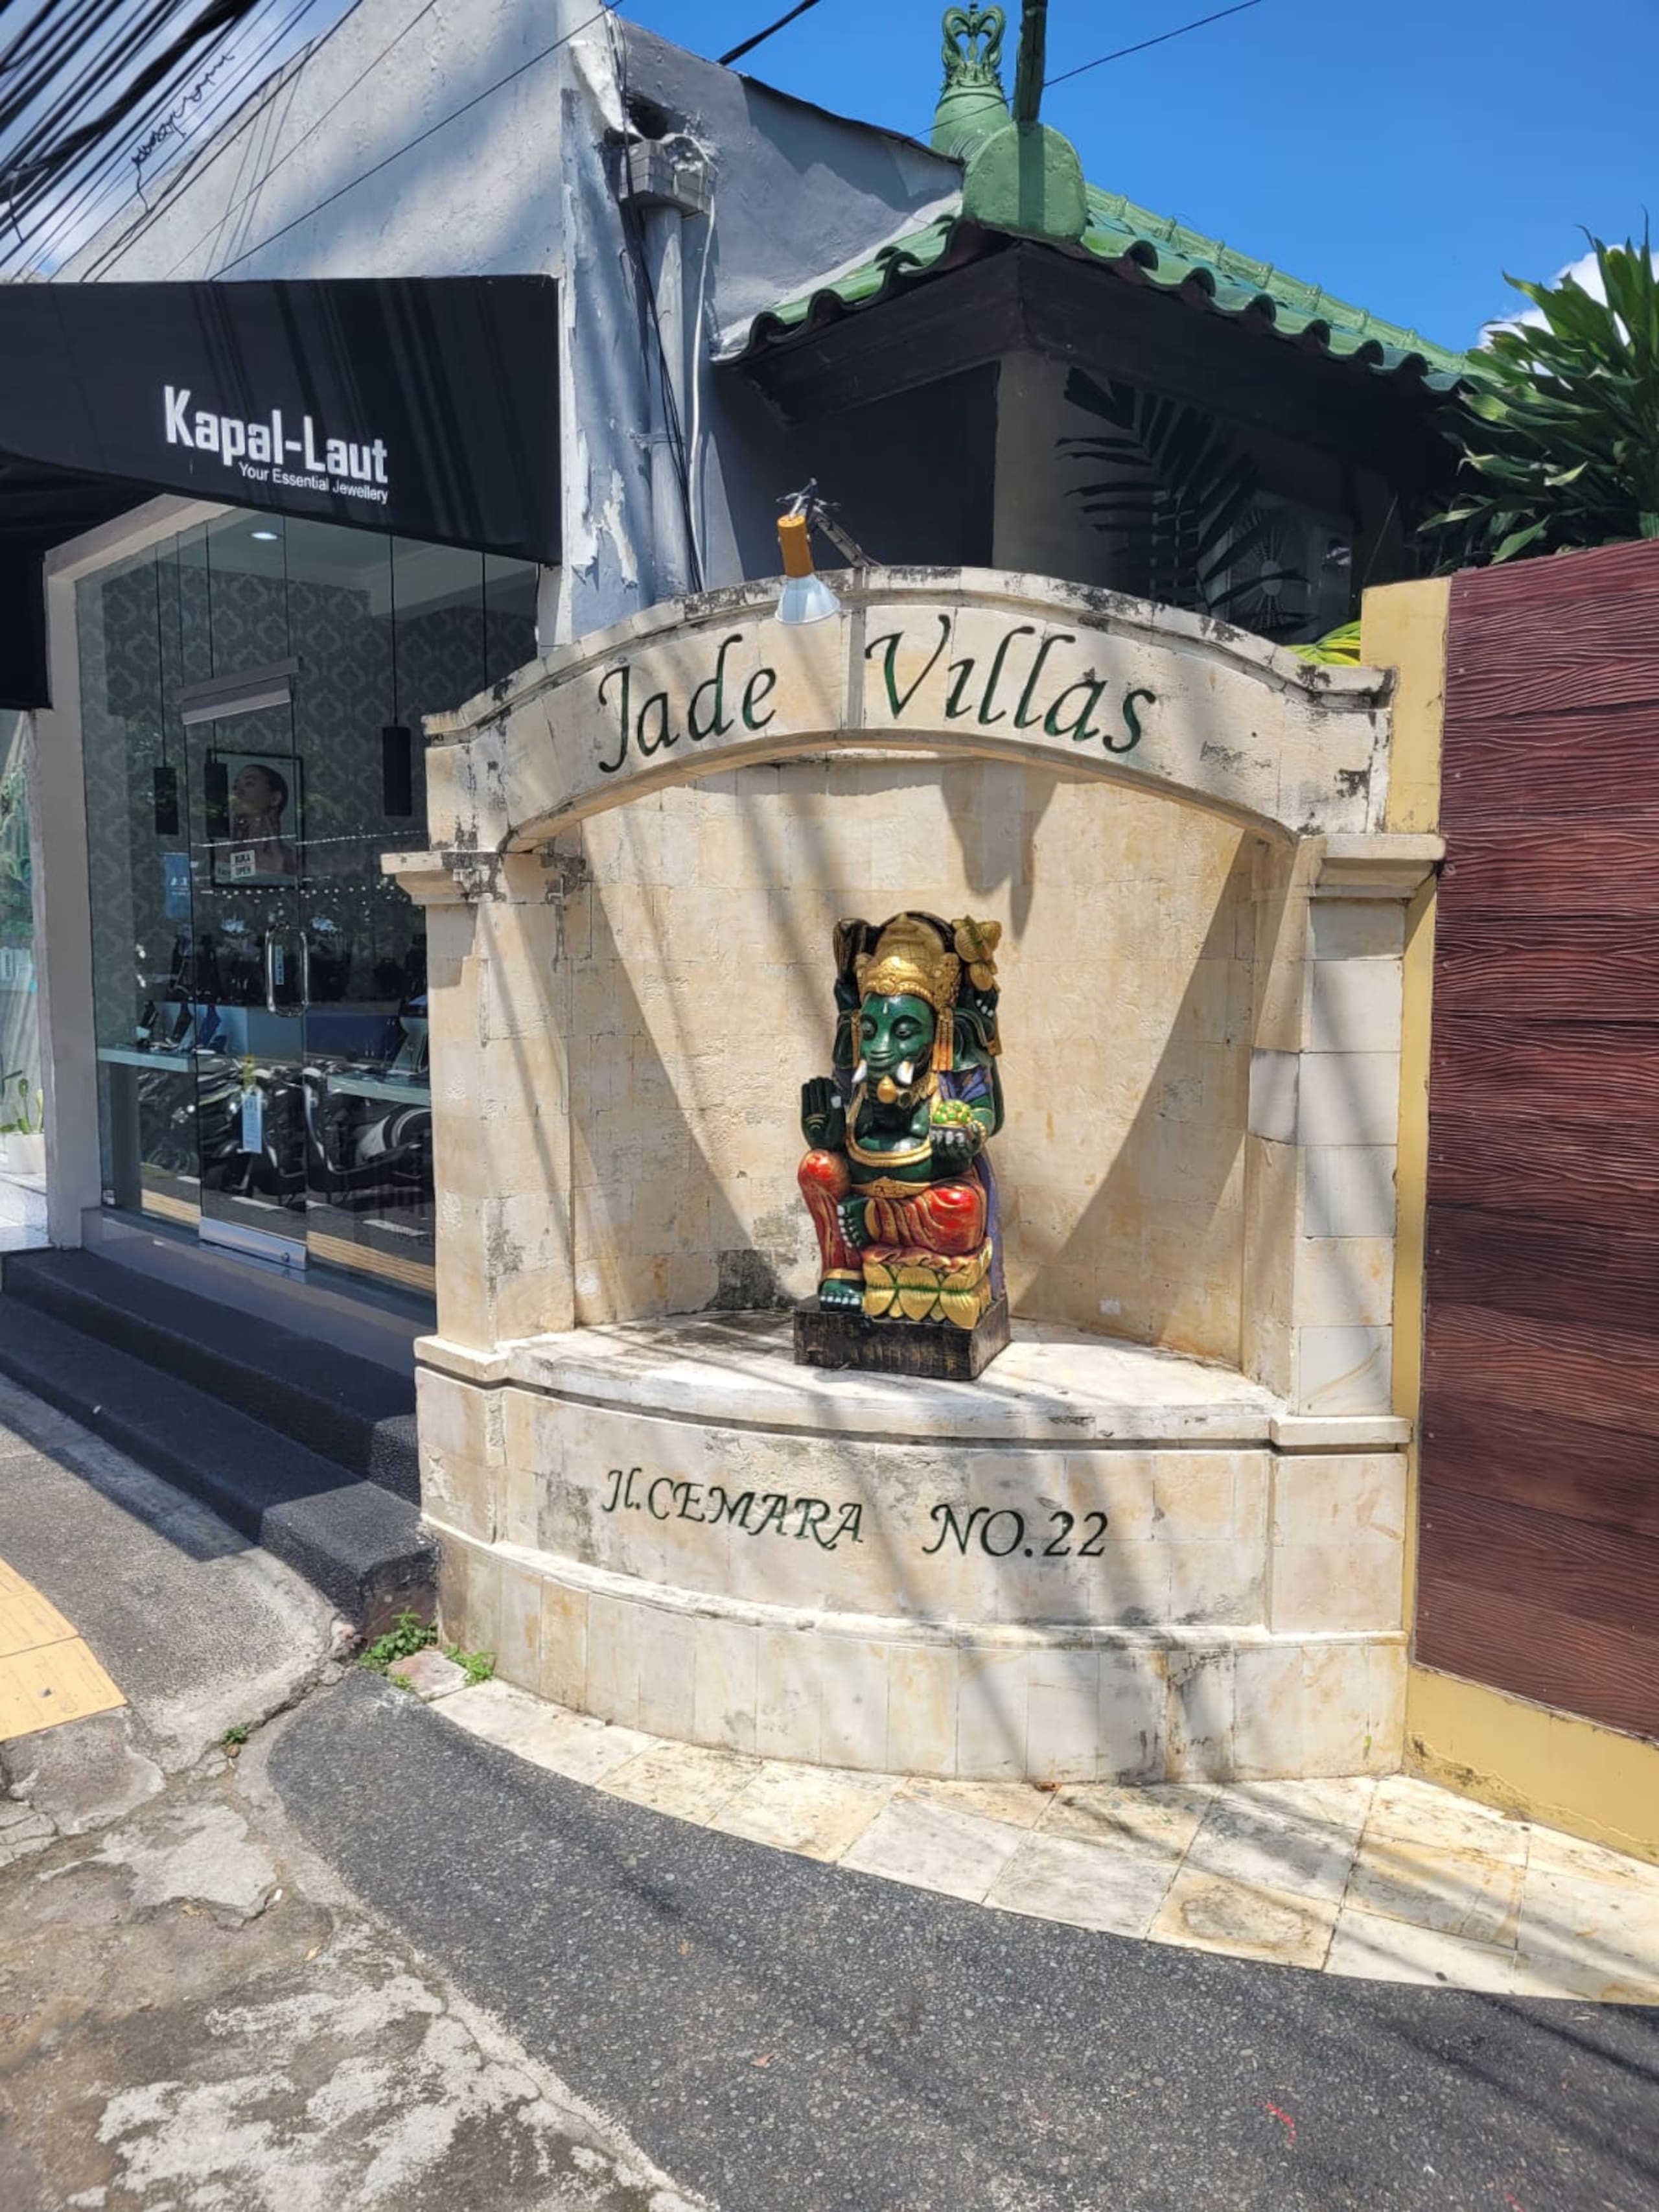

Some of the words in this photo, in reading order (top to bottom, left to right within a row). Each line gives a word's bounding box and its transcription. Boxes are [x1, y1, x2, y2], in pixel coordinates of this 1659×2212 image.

[164, 384, 389, 483] Kapal-Laut
[238, 461, 270, 482] Your
[272, 467, 329, 492] Essential
[332, 479, 389, 506] Jewellery
[597, 633, 776, 774] Jade
[864, 613, 1156, 754] Villas
[922, 1504, 1109, 1557] NO.22
